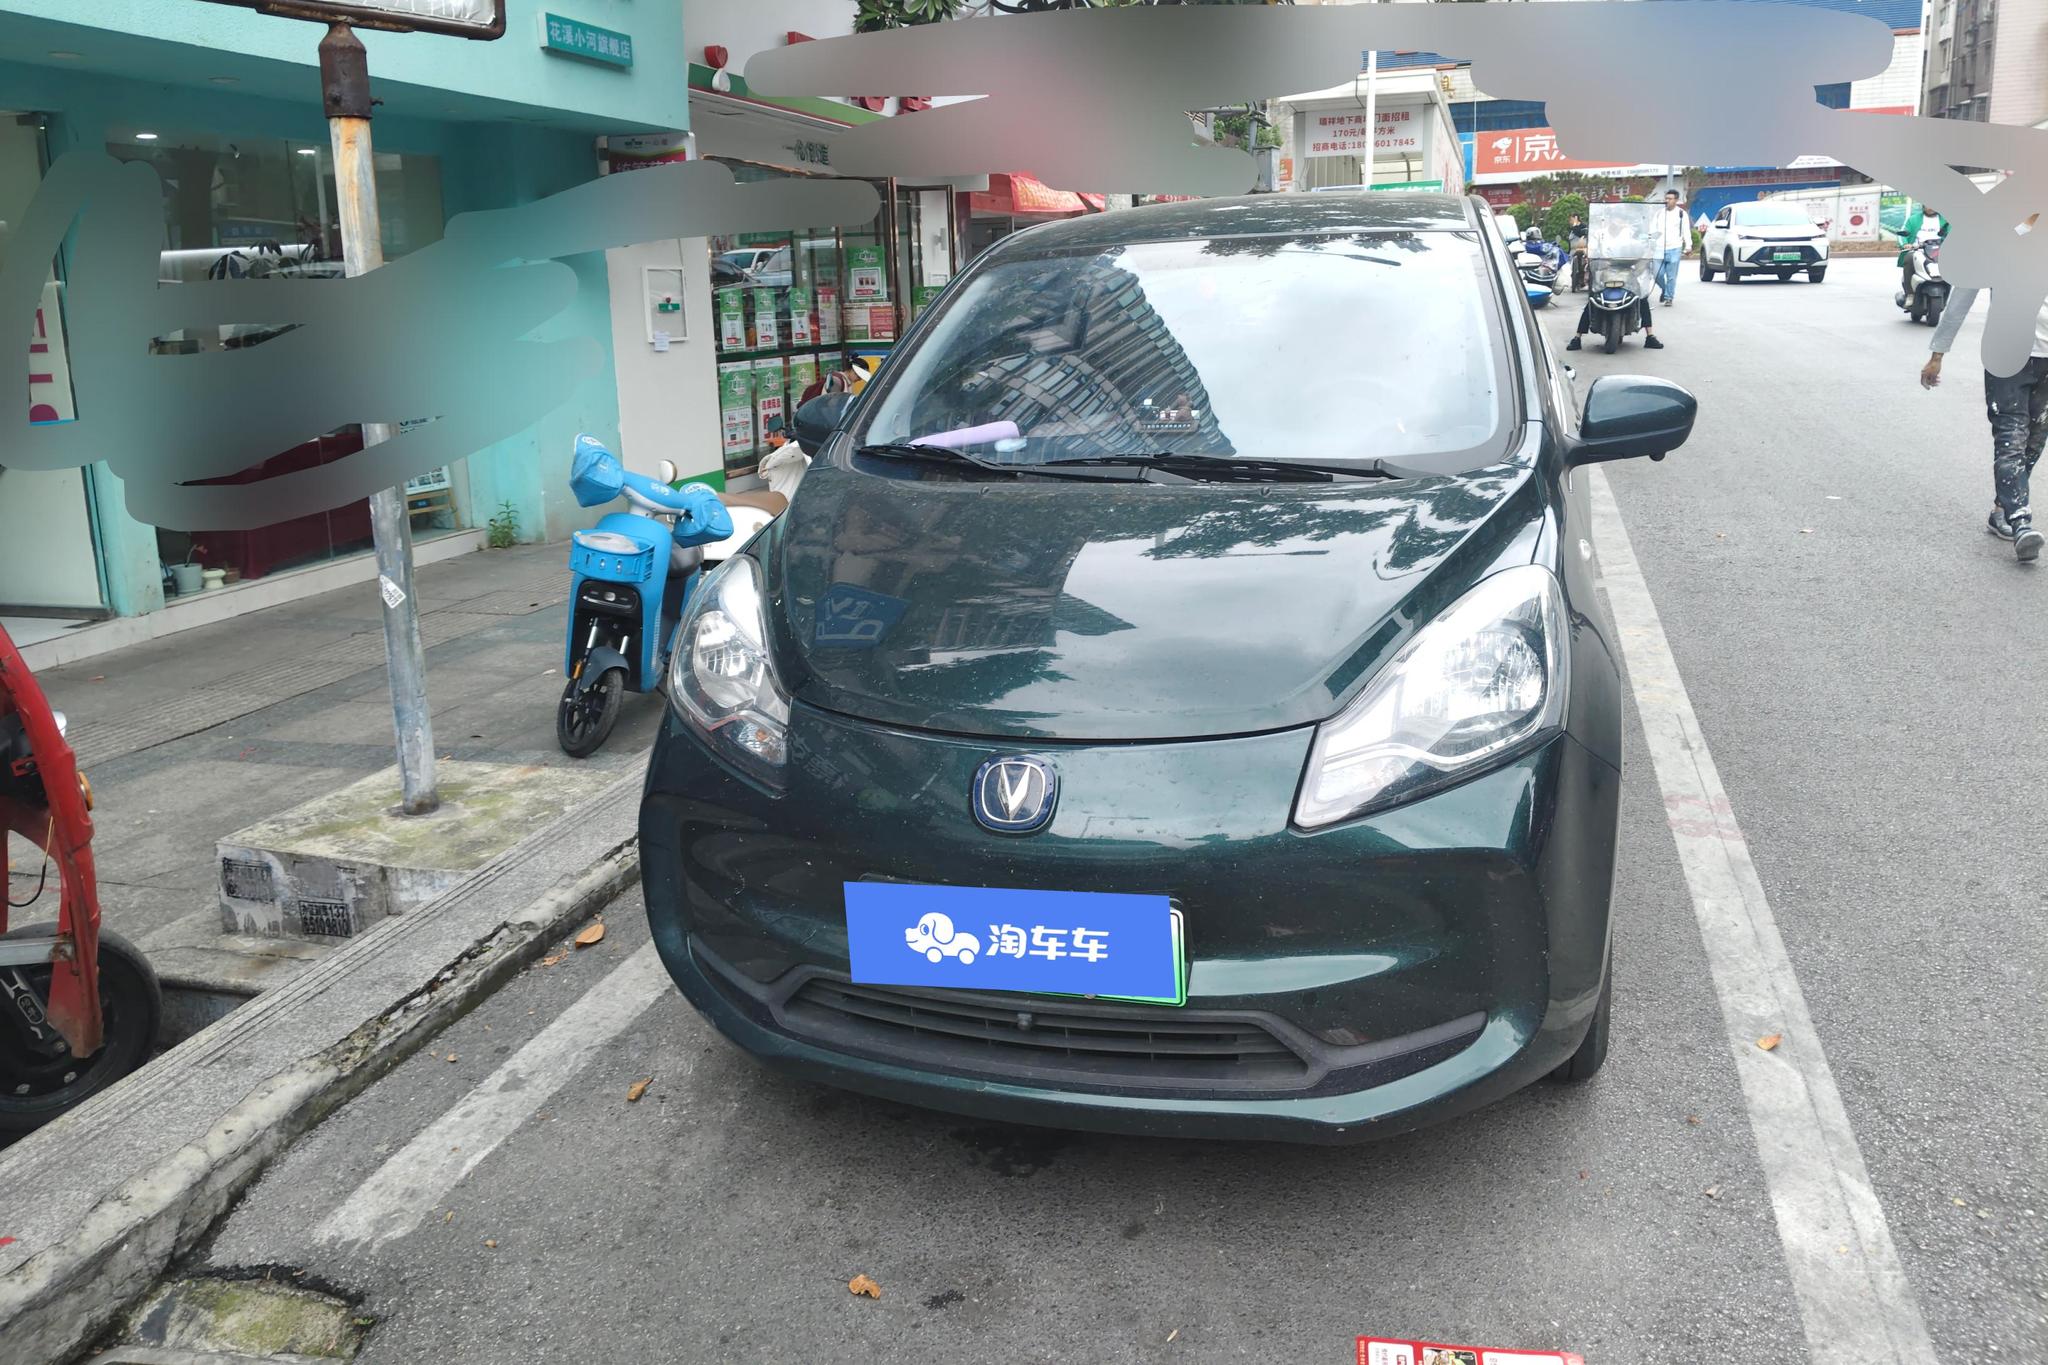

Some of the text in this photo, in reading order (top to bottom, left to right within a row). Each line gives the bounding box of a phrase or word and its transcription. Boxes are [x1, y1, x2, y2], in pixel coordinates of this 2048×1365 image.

[549, 20, 630, 59] 花溪小河旗舰店
[1319, 111, 1410, 126] 瑞祥地下商门面招租
